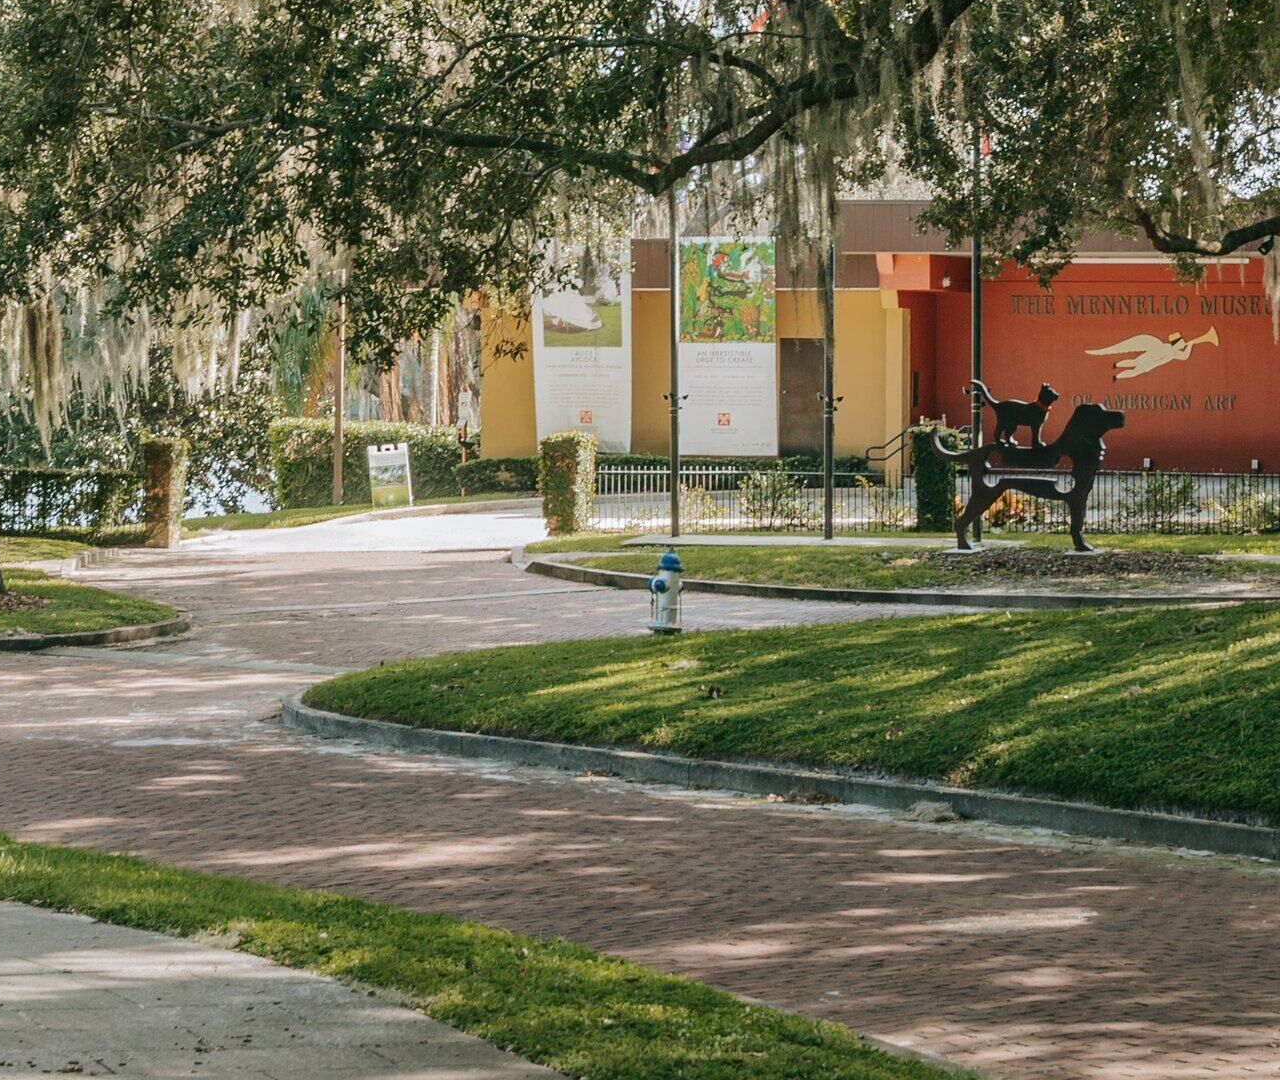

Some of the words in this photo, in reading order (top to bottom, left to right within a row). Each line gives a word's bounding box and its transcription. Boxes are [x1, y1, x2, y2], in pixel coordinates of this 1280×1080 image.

[1011, 294, 1055, 315] THE
[1067, 294, 1190, 315] MENNELLO
[1104, 393, 1192, 410] AMERICAN
[1204, 394, 1237, 410] ART
